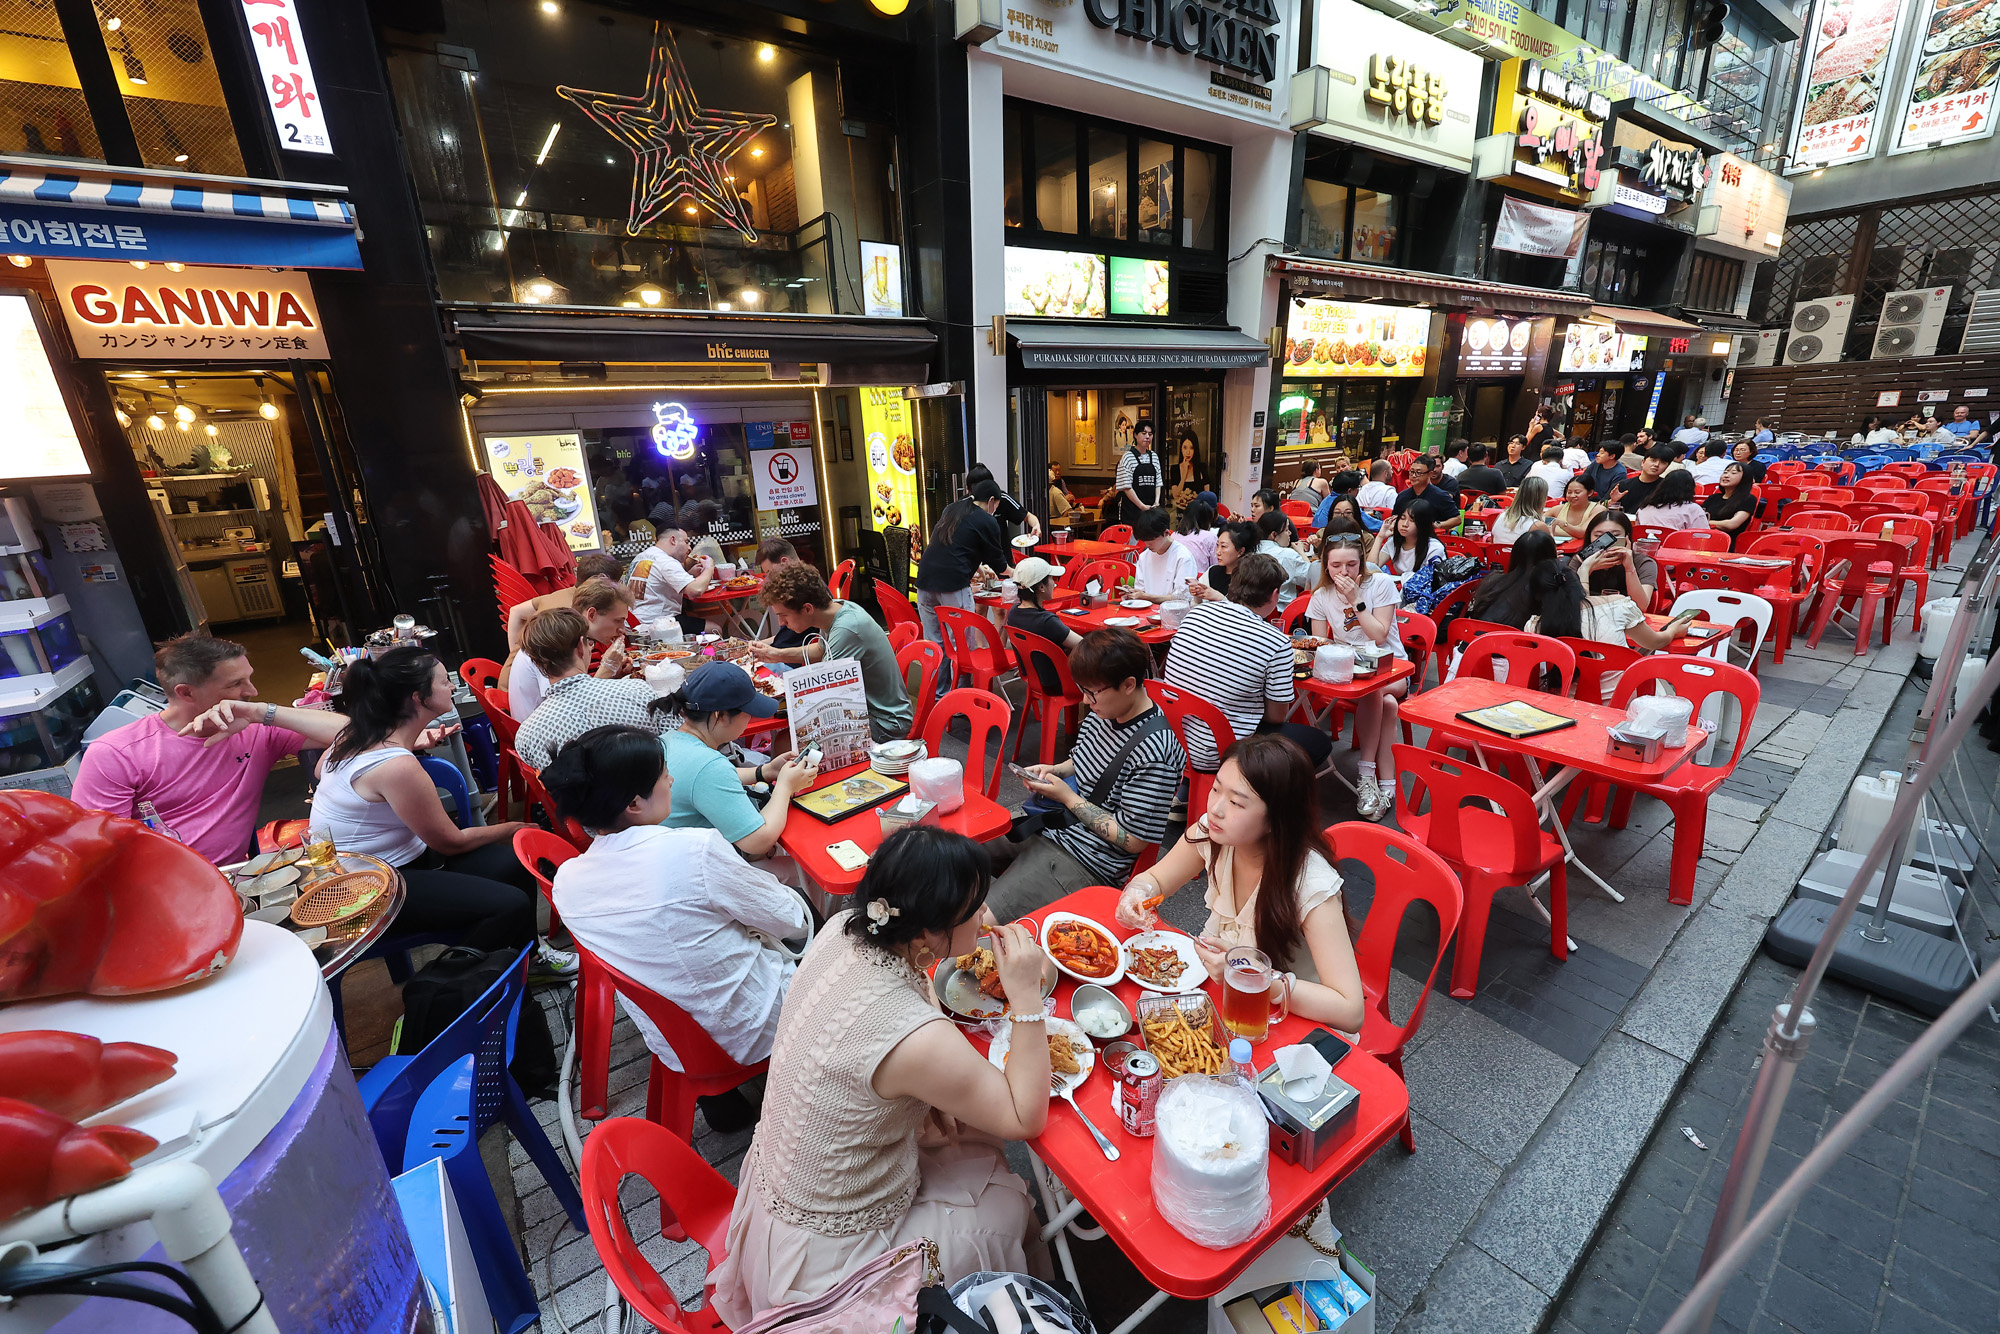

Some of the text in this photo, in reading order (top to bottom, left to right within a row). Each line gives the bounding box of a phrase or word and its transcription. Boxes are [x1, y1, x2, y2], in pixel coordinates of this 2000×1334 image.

[1510, 30, 1530, 51] FOOD
[242, 0, 315, 118] 개와
[1594, 60, 1613, 89] NY
[1912, 92, 1990, 119] 명동조개와
[1802, 117, 1871, 141] 명동조개와
[71, 284, 315, 328] GANIWA
[99, 333, 309, 351] カンジャンケジャン定食
[706, 343, 770, 359] bhc CHICKEN
[1033, 353, 1072, 363] PURADAK
[1073, 353, 1095, 363] SHOP
[1095, 354, 1130, 363] CHICKEN
[1130, 354, 1136, 363] &
[1137, 354, 1156, 363] BEER
[1160, 355, 1180, 363] SINCE
[1181, 355, 1194, 363] 2014
[1197, 355, 1226, 363] PURADAK
[616, 449, 632, 459] bhc
[872, 453, 886, 467] BHC
[708, 518, 730, 533] bhc
[780, 510, 800, 525] bhc
[629, 526, 653, 542] bhc
[792, 667, 858, 692] SHINSEGAE
[817, 702, 843, 713] SHINSEGAE
